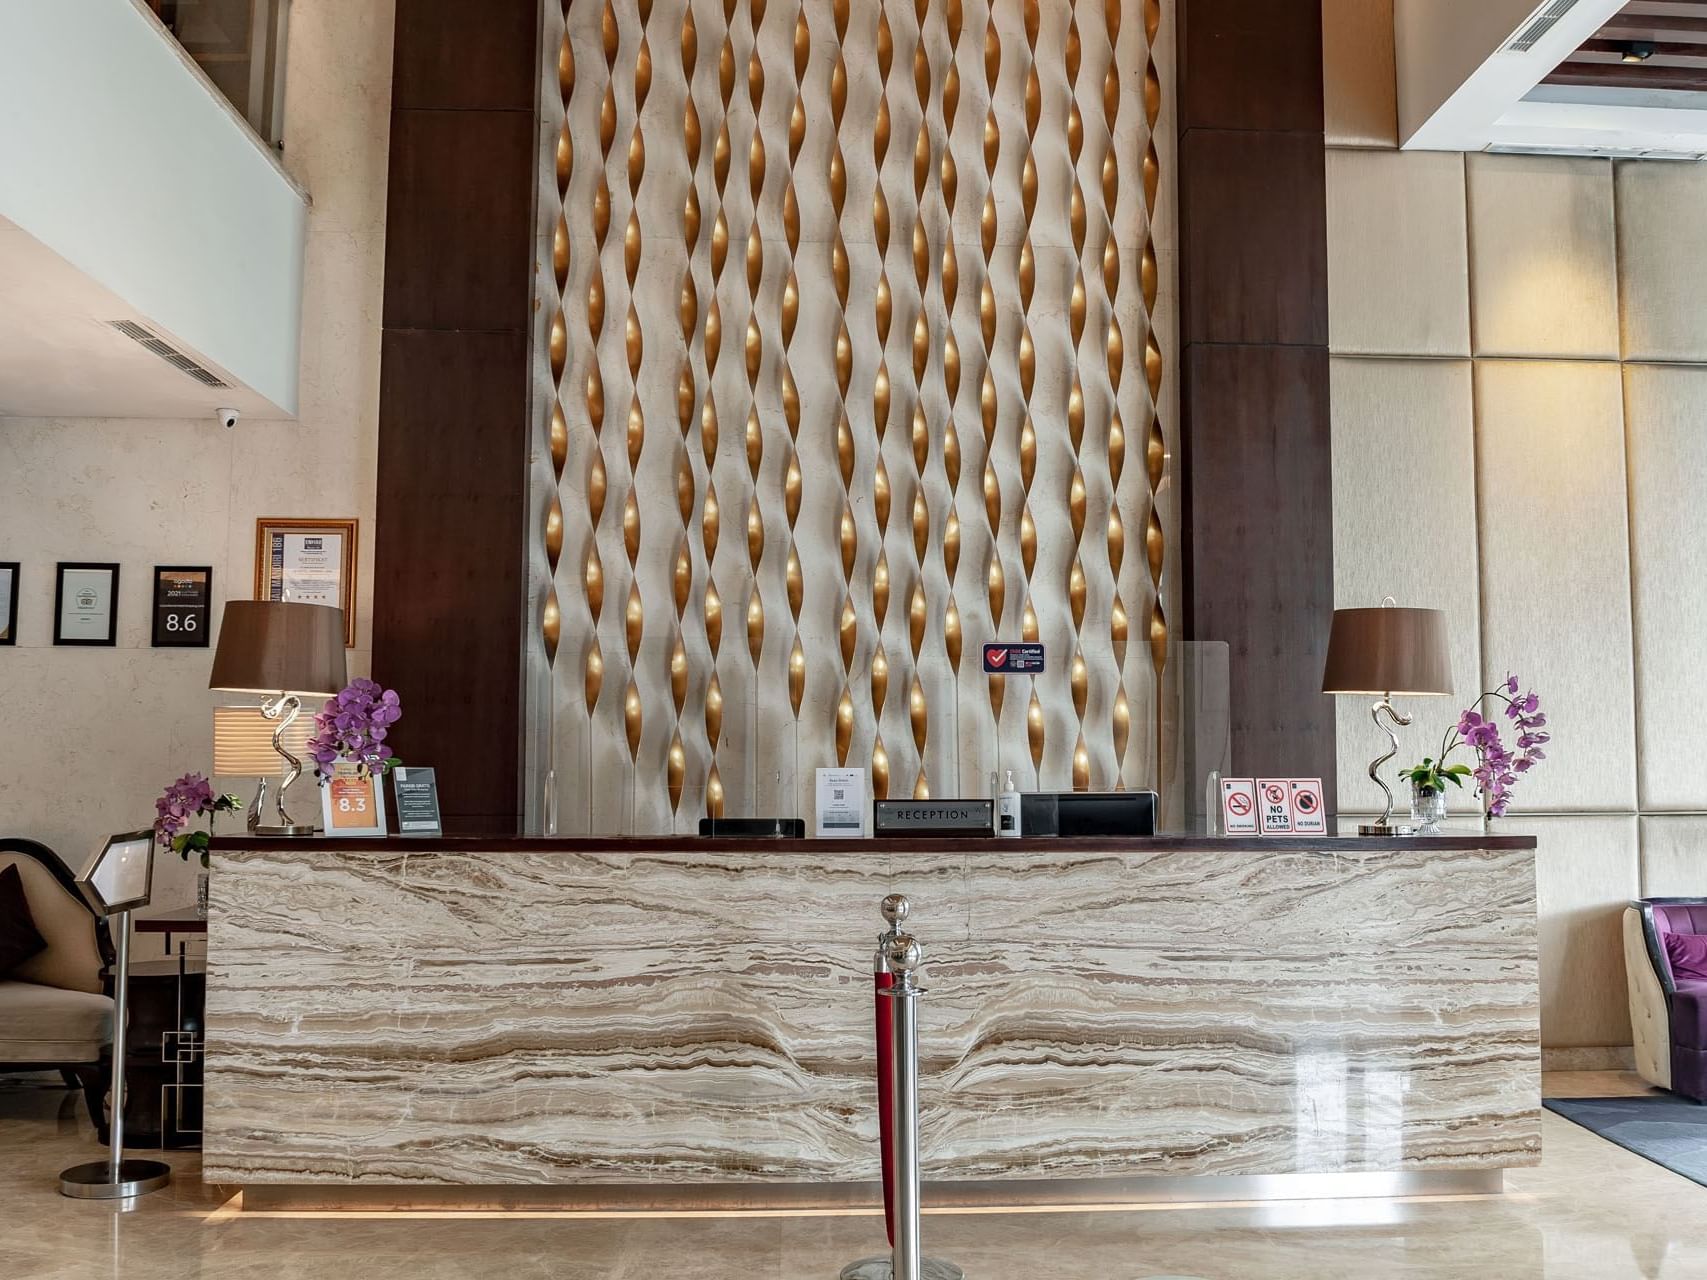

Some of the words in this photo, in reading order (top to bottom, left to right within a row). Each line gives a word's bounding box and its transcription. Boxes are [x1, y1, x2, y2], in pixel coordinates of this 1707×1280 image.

[166, 614, 197, 631] 8.6
[339, 798, 366, 812] 8.3
[1270, 806, 1283, 814] NO
[897, 810, 968, 820] RECEPTION
[1266, 815, 1289, 823] PETS
